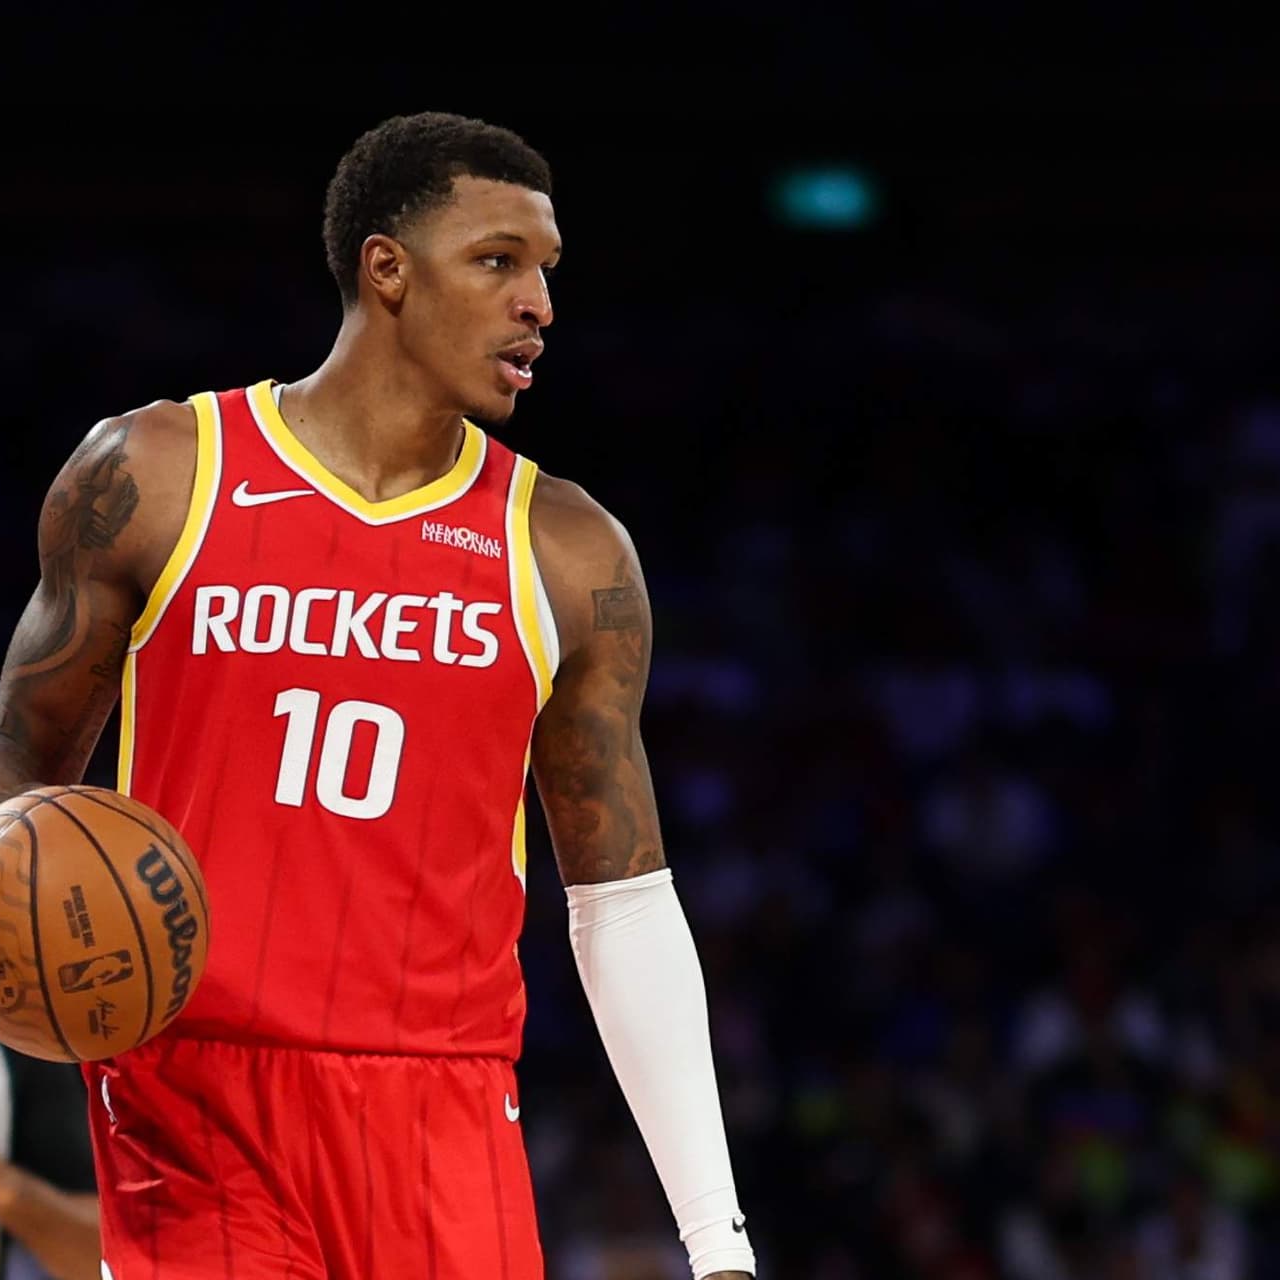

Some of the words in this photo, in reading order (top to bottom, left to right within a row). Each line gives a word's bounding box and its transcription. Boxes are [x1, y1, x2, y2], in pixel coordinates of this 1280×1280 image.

[421, 531, 502, 559] HERMANN
[422, 520, 500, 549] MEMORIAL
[192, 584, 502, 668] ROCKETS
[272, 687, 406, 819] 10
